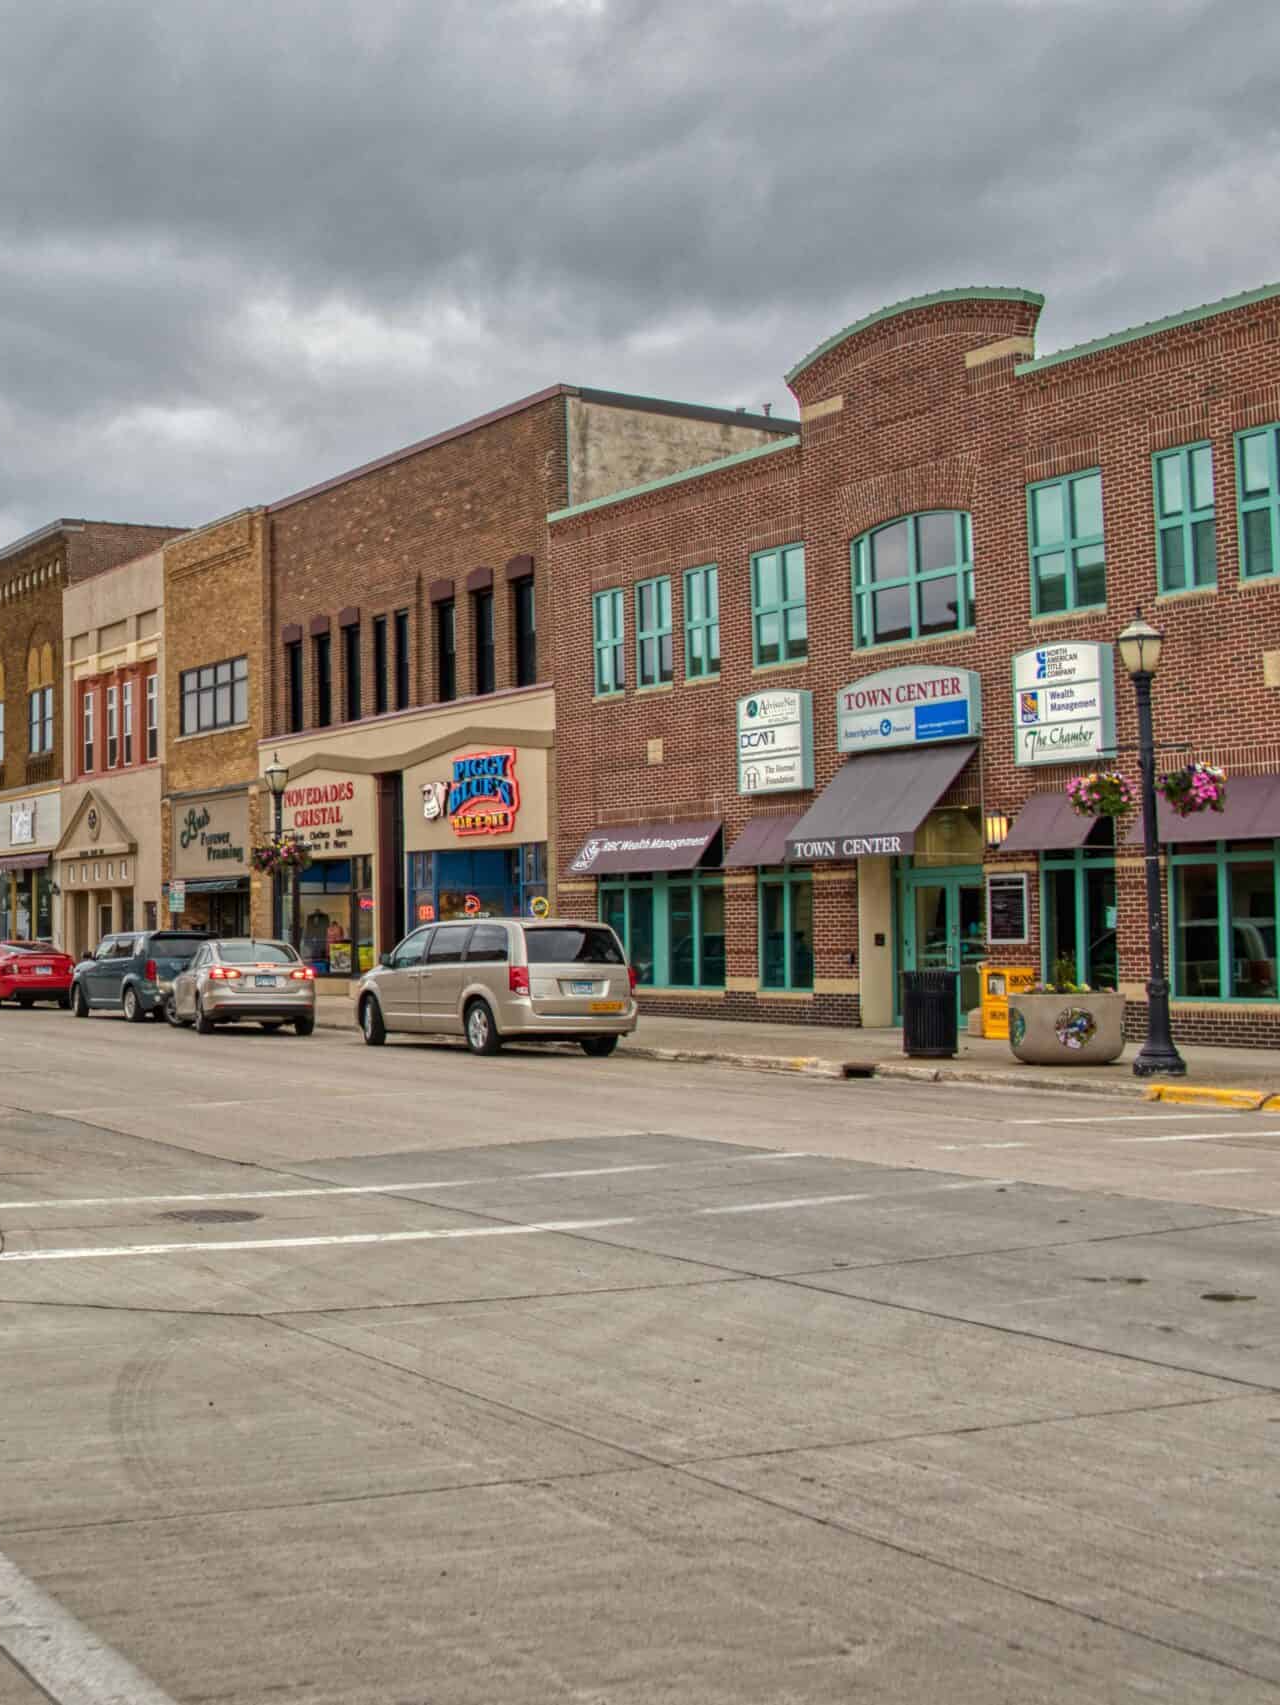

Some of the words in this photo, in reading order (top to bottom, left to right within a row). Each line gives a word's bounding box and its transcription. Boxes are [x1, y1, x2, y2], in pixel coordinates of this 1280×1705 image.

[1047, 648, 1067, 657] NORTH
[1047, 653, 1078, 663] AMERICAN
[1047, 663, 1063, 671] TITLE
[1047, 668, 1077, 678] COMPANY
[844, 687, 892, 710] TOWN
[895, 676, 962, 703] CENTER
[1049, 688, 1075, 700] Wealth
[1050, 698, 1097, 712] Management
[1024, 729, 1048, 760] The
[1049, 723, 1095, 744] Chamber
[453, 755, 507, 781] PIGGY
[284, 782, 354, 808] NOVEDADES
[294, 806, 344, 828] CRISTAL
[207, 846, 244, 863] Framing
[794, 841, 836, 857] TOWN
[842, 837, 901, 855] CENTER
